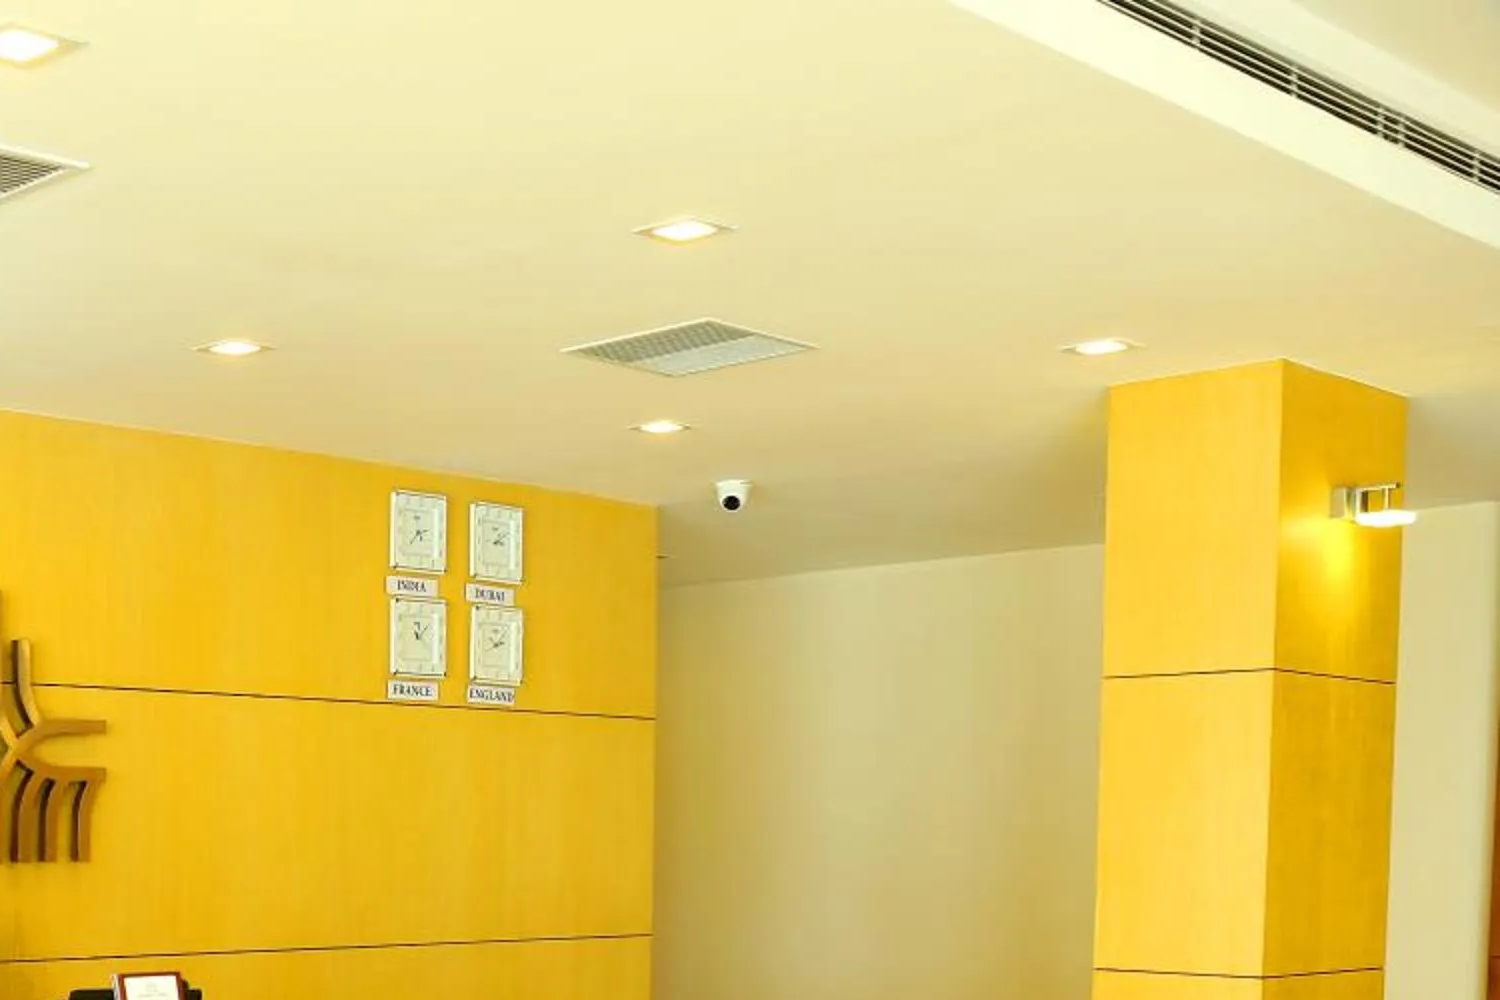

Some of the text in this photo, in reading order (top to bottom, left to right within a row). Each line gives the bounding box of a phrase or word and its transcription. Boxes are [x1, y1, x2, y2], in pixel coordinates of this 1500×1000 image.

[397, 579, 427, 593] INDIA
[475, 588, 505, 602] DUBAI
[393, 684, 433, 697] FRANCE
[469, 688, 515, 702] ENGLAND
